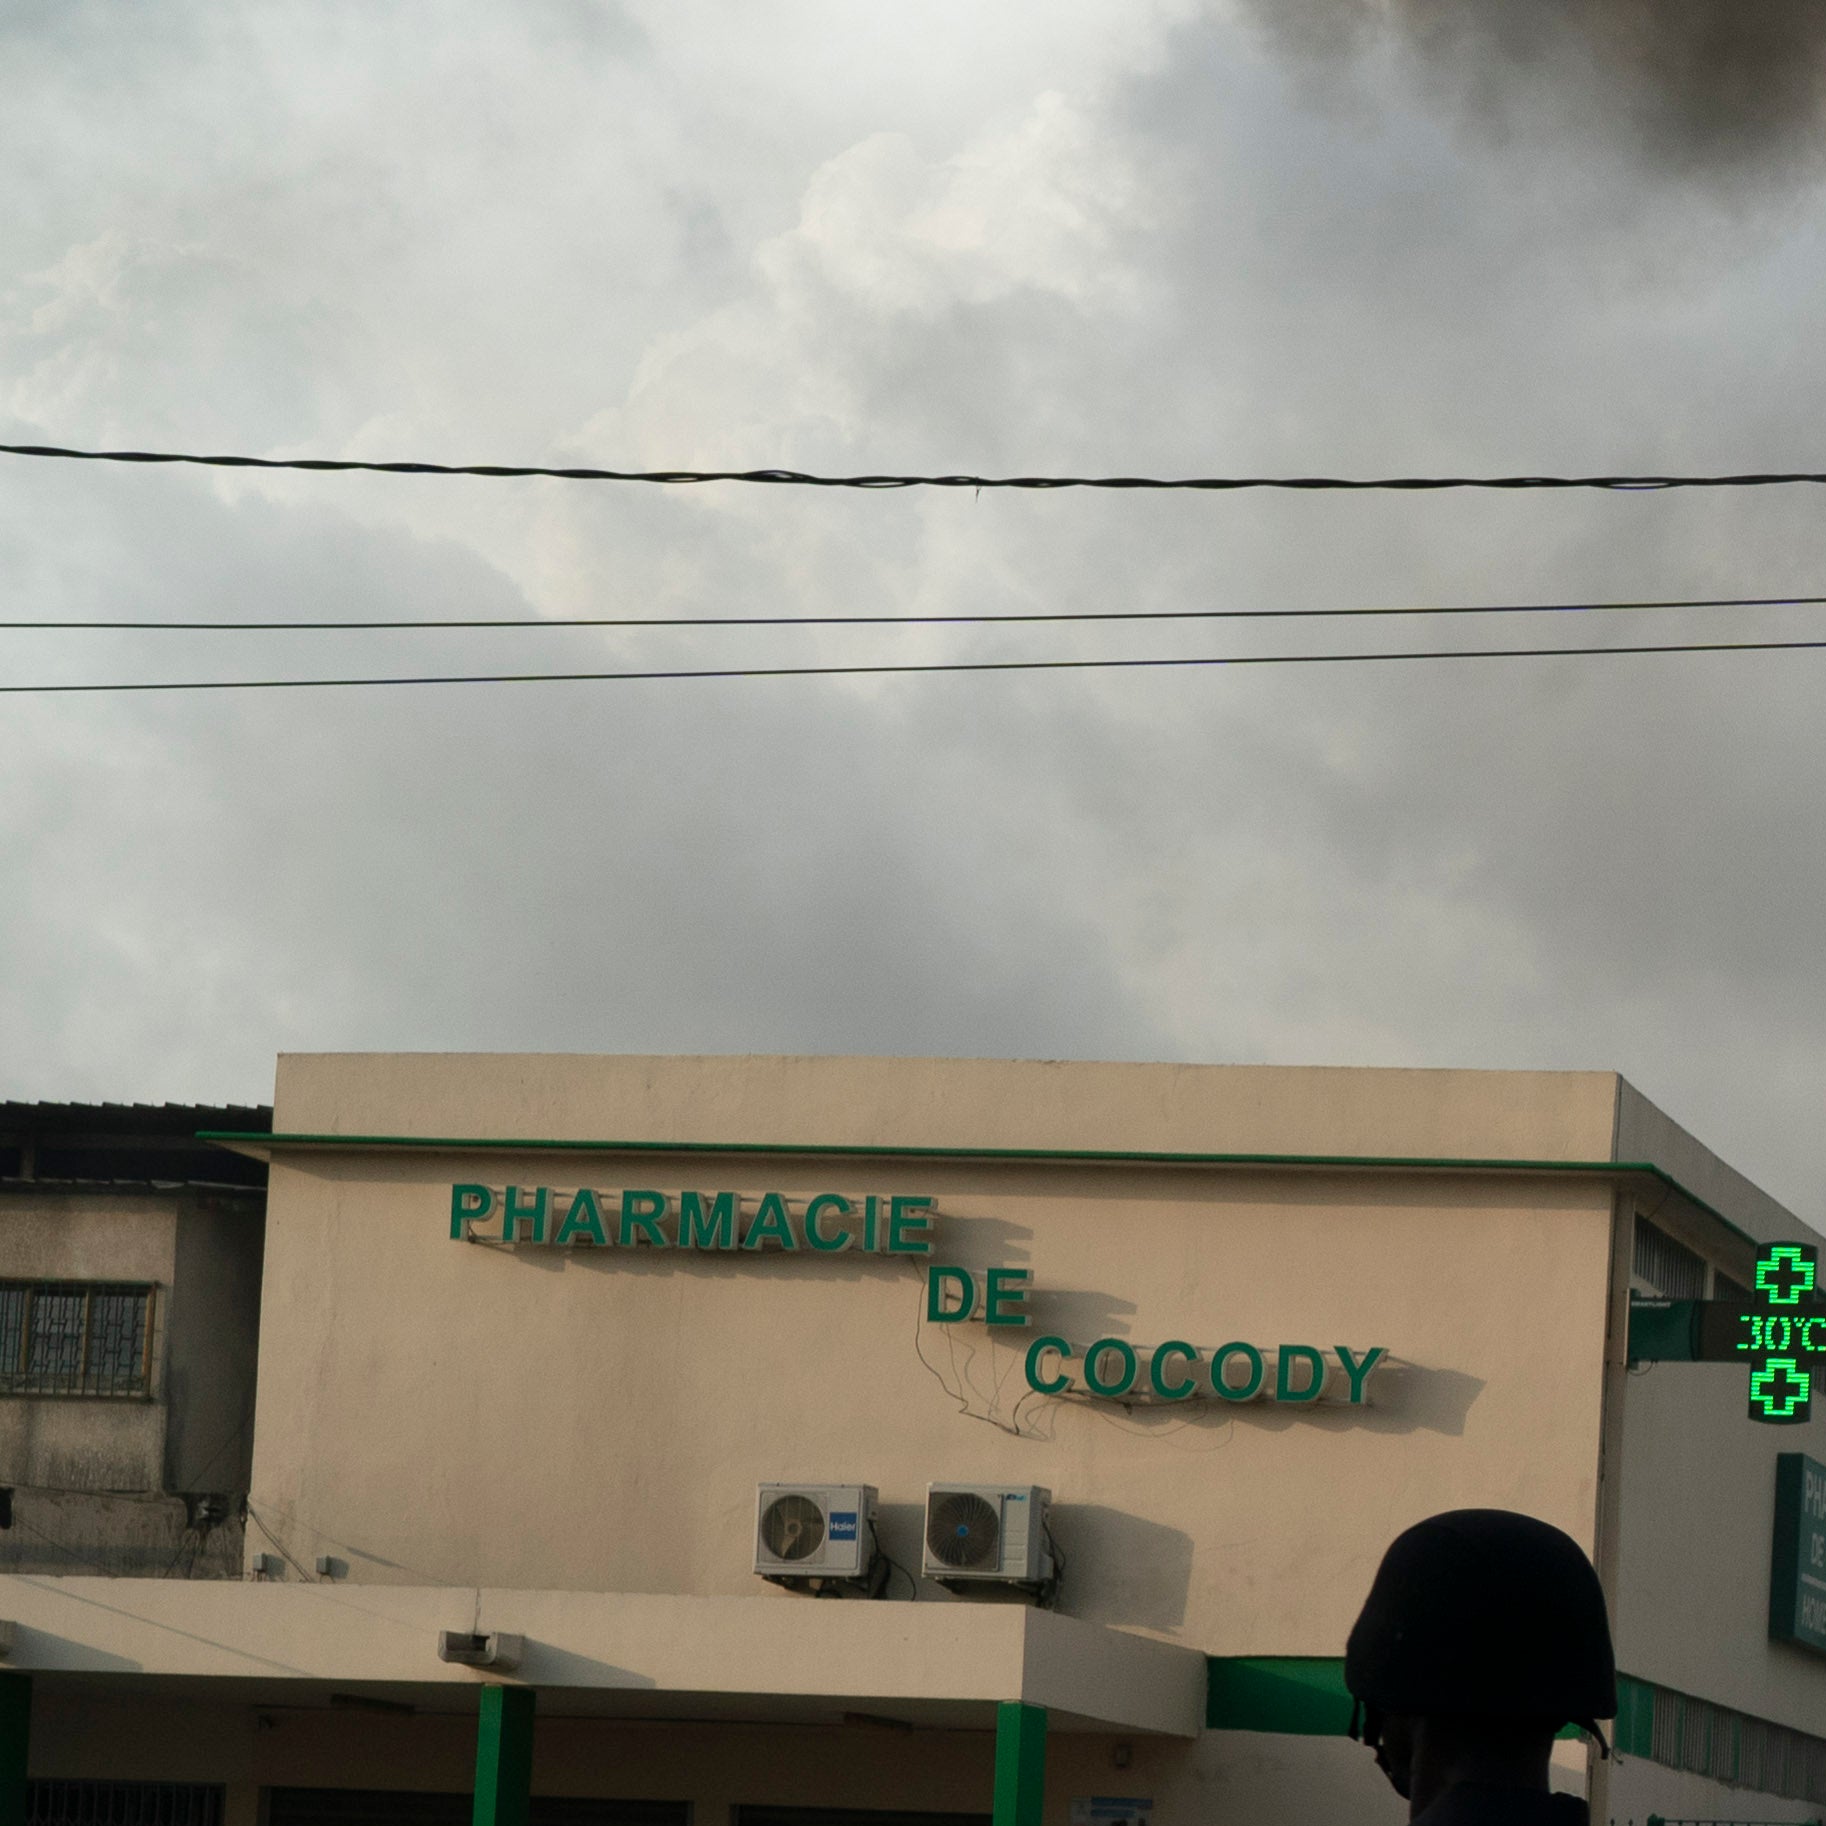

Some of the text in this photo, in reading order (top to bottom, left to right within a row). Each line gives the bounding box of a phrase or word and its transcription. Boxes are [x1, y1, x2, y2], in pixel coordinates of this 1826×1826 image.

[451, 1184, 937, 1256] PHARMACIE
[928, 1266, 1034, 1326] DE
[1025, 1338, 1390, 1404] COCODY
[830, 1520, 857, 1533] Haier
[1811, 1532, 1825, 1569] DE
